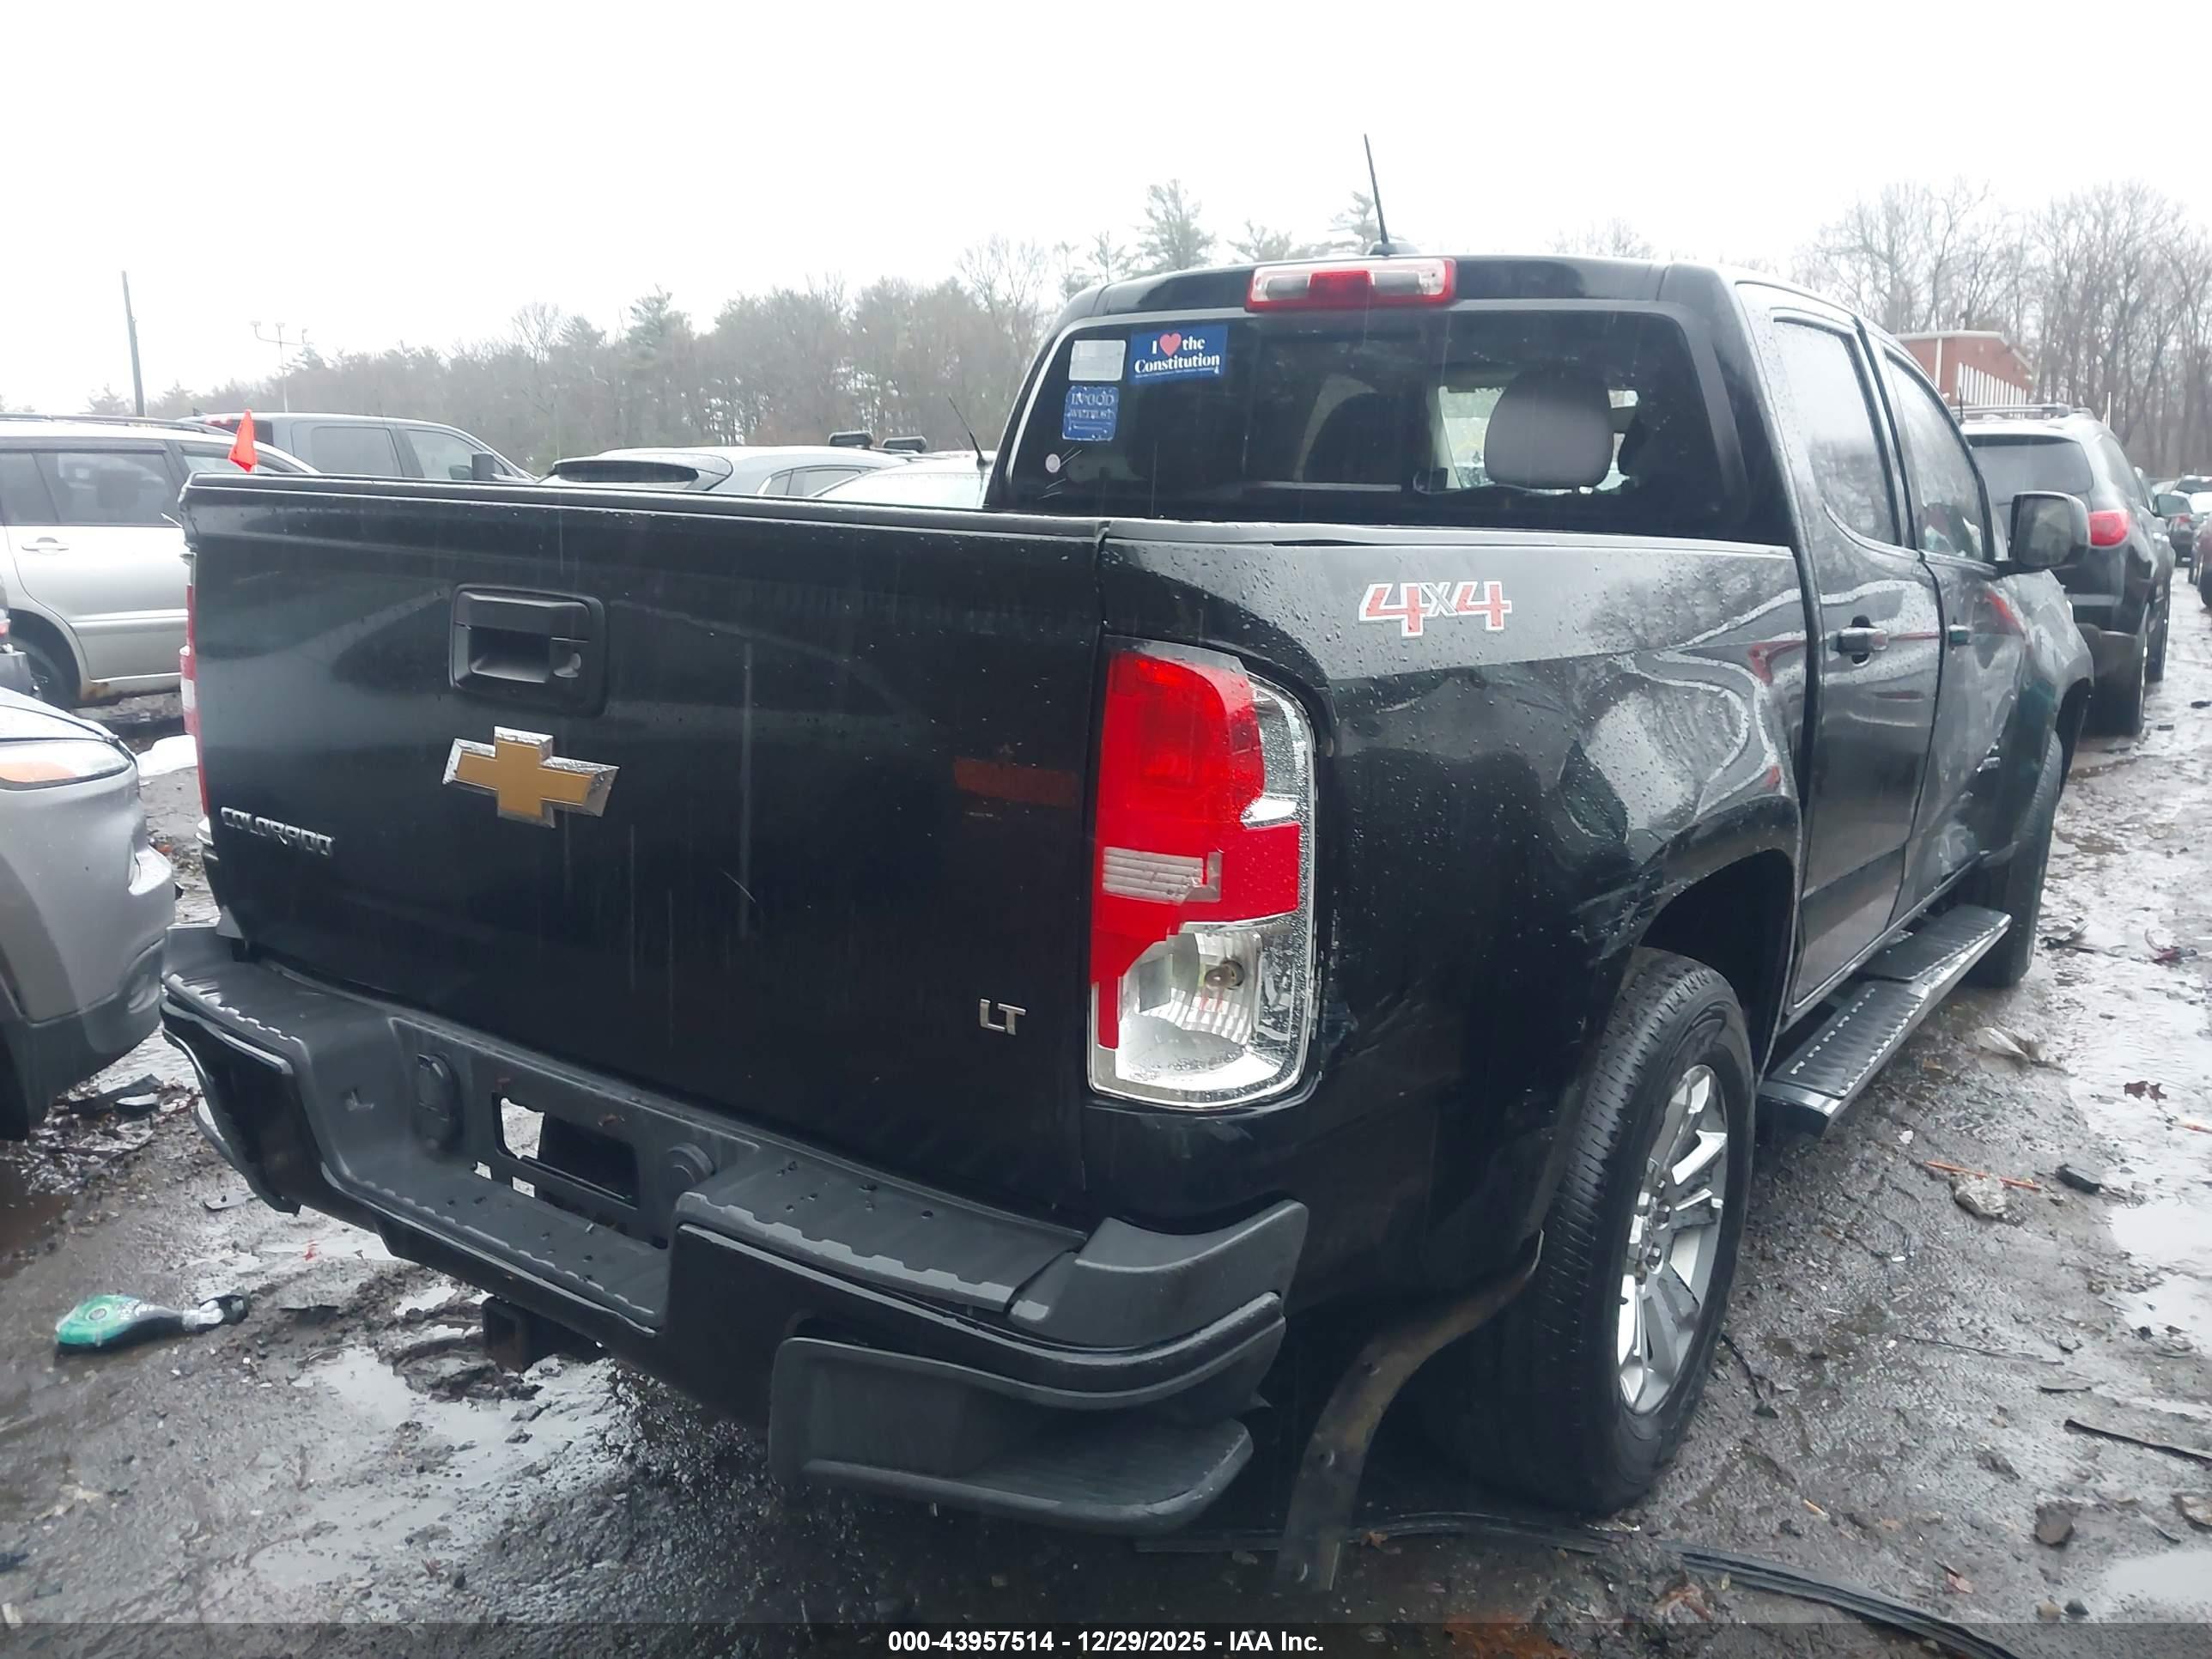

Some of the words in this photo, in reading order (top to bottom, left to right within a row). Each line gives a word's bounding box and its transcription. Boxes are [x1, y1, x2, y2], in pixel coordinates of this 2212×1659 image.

[1152, 340, 1158, 355] I
[1182, 335, 1206, 351] the
[1134, 352, 1220, 374] Constitution
[220, 805, 333, 856] COLORADO
[980, 998, 1027, 1036] LT
